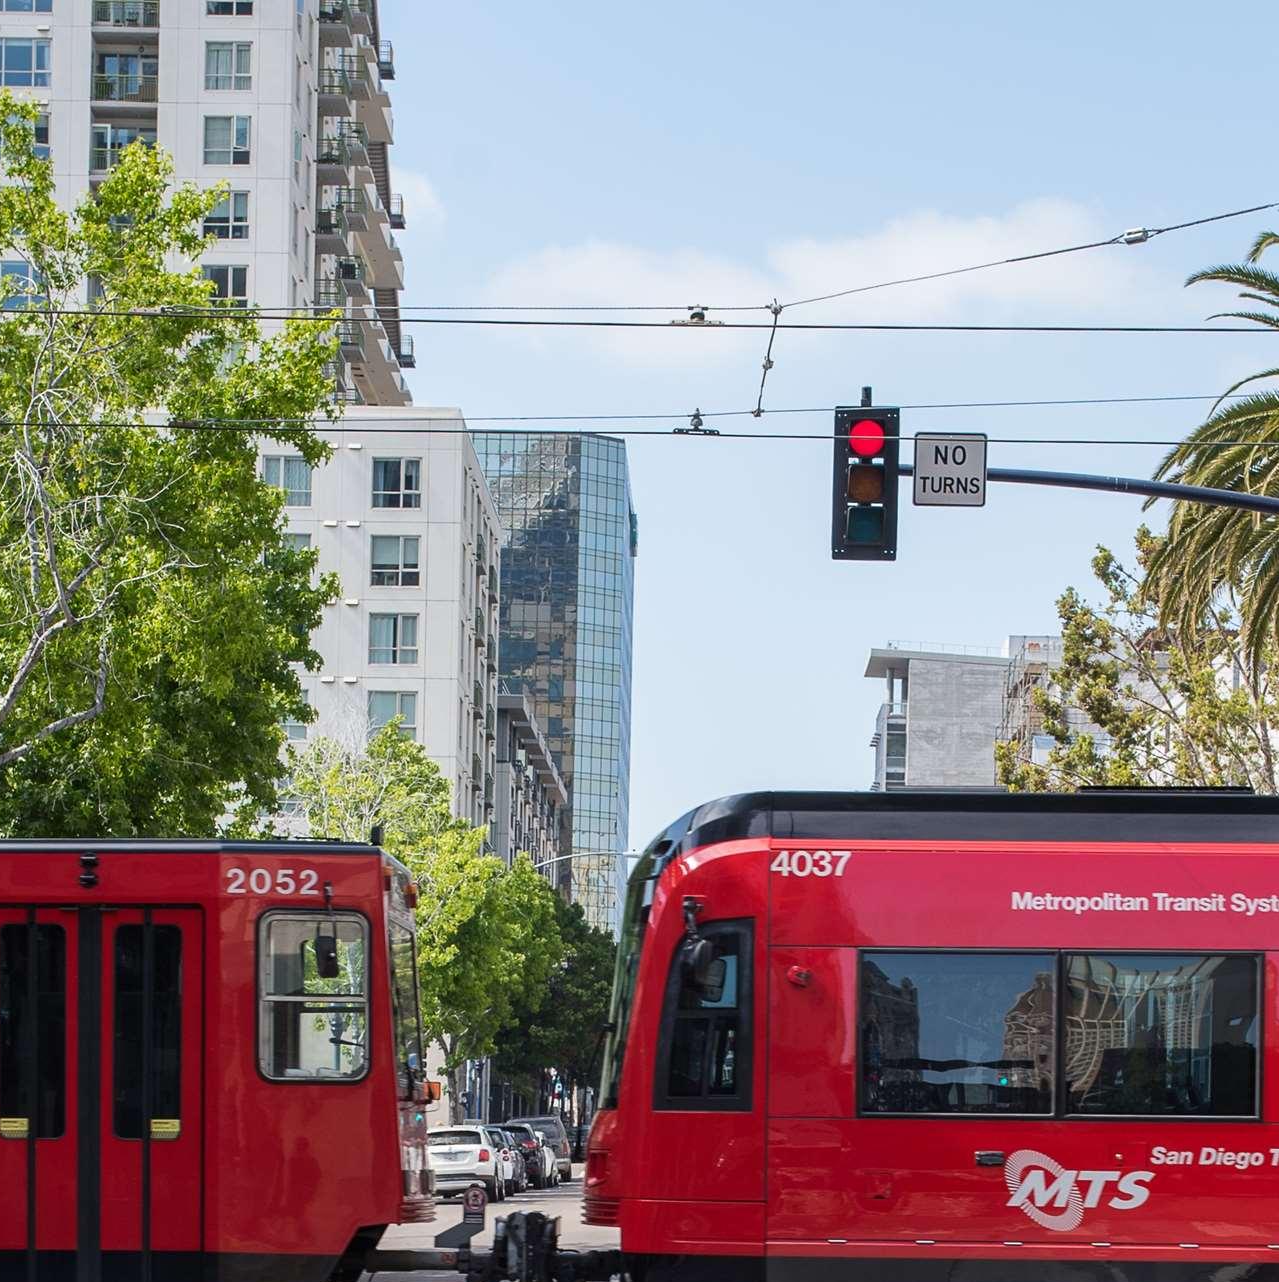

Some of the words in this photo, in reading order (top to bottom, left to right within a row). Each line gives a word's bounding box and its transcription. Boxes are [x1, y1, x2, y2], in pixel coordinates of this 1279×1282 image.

[934, 445, 967, 466] NO
[919, 476, 981, 495] TURNS
[770, 850, 852, 877] 4037
[226, 867, 319, 895] 2052
[1011, 891, 1149, 915] Metropolitan
[1152, 892, 1226, 912] Transit
[1150, 1146, 1194, 1166] San
[1198, 1147, 1265, 1170] Diego
[1006, 1169, 1155, 1210] MTS
